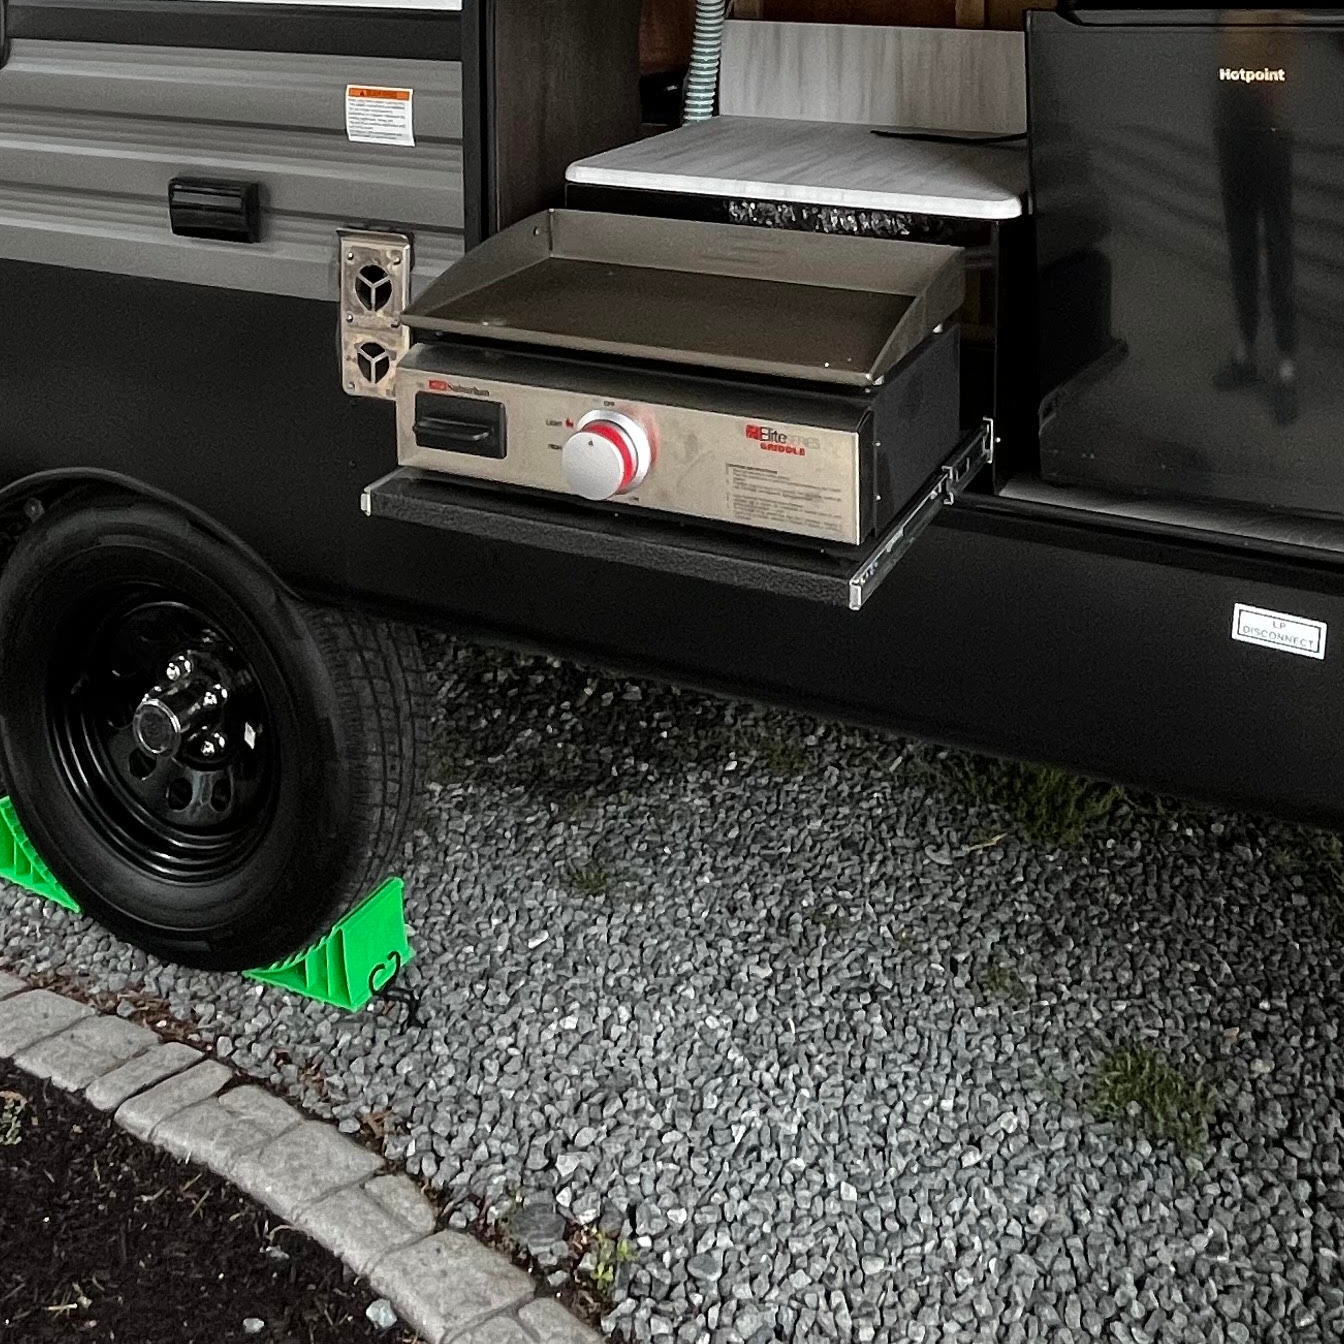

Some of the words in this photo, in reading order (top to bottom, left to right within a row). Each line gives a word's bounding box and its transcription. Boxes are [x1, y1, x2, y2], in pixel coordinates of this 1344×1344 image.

[1219, 68, 1286, 83] Hotpoint
[759, 426, 788, 444] Elite
[1272, 620, 1287, 630] LP
[1242, 625, 1315, 649] DISCONNECT
